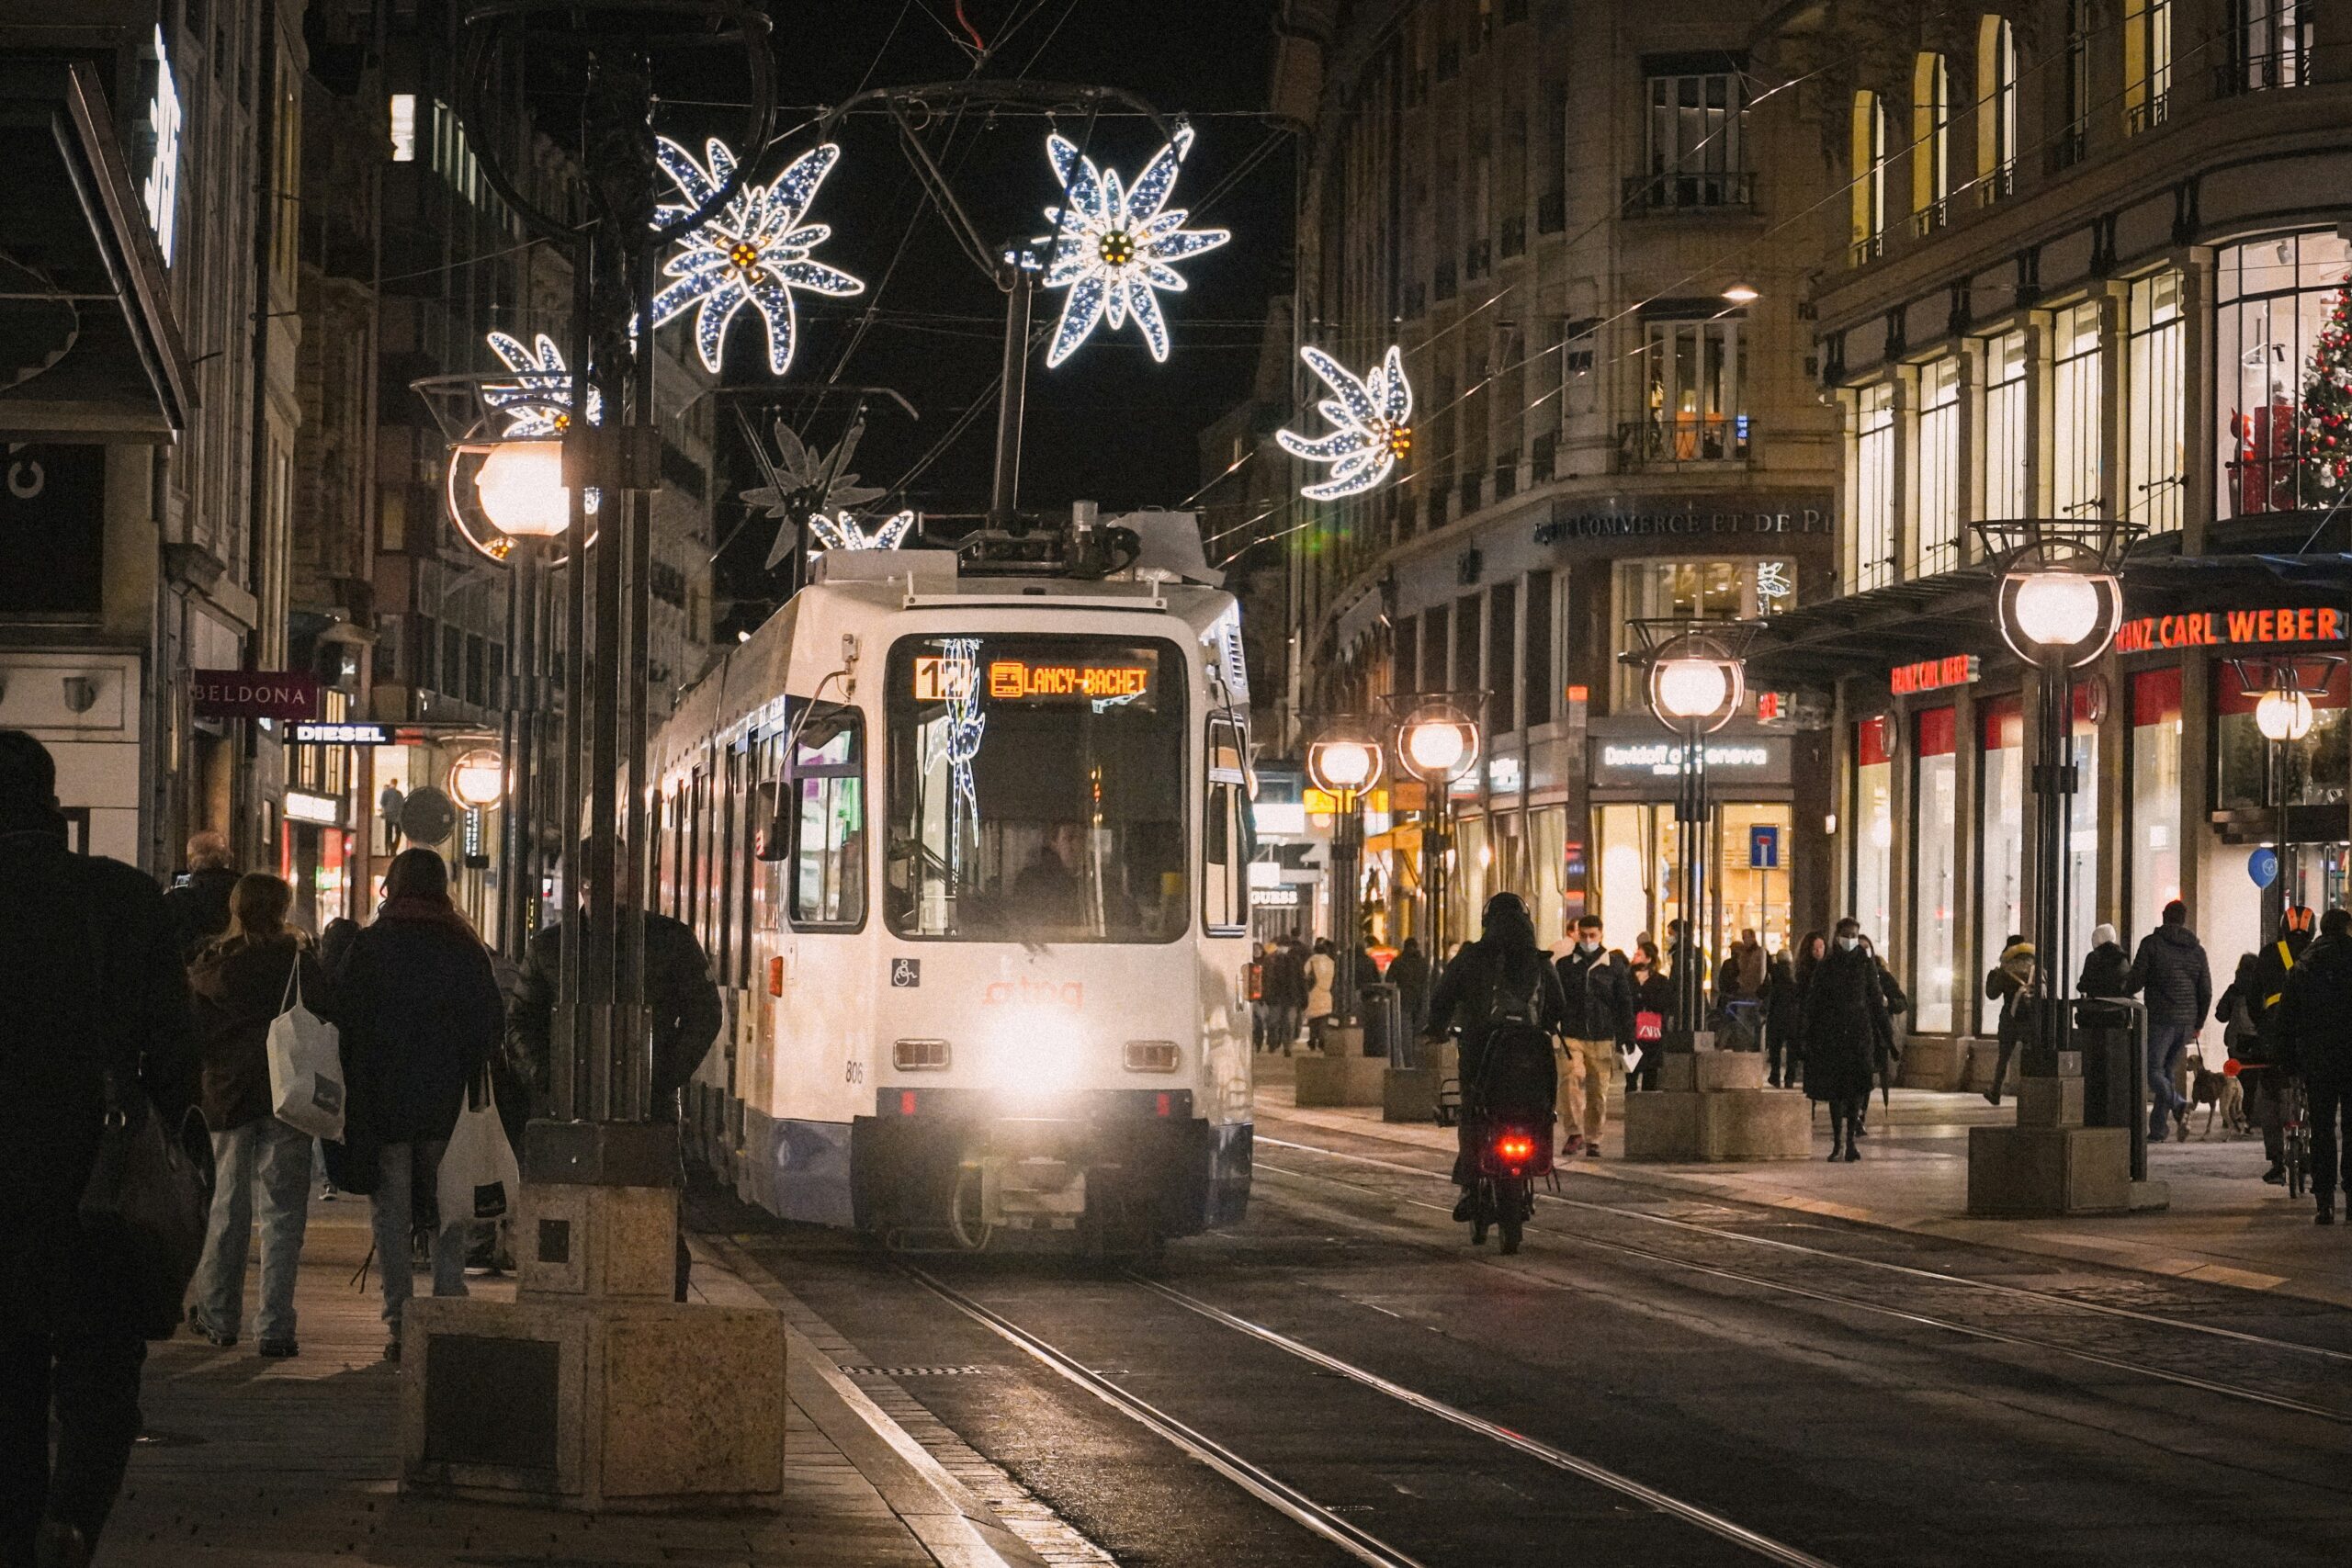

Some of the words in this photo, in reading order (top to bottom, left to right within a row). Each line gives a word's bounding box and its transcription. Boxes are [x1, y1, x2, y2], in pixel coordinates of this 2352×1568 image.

[1577, 513, 1701, 536] COMMERCE
[1713, 512, 1744, 533] ET
[1754, 513, 1791, 533] DE
[2116, 616, 2154, 652] RANZ
[2160, 612, 2218, 649] CARL
[2228, 607, 2338, 643] WEBER
[1023, 667, 1148, 695] LANCY-BACHET
[194, 685, 305, 705] BELDONA
[296, 726, 386, 742] DIESEL
[845, 1060, 864, 1085] 806
